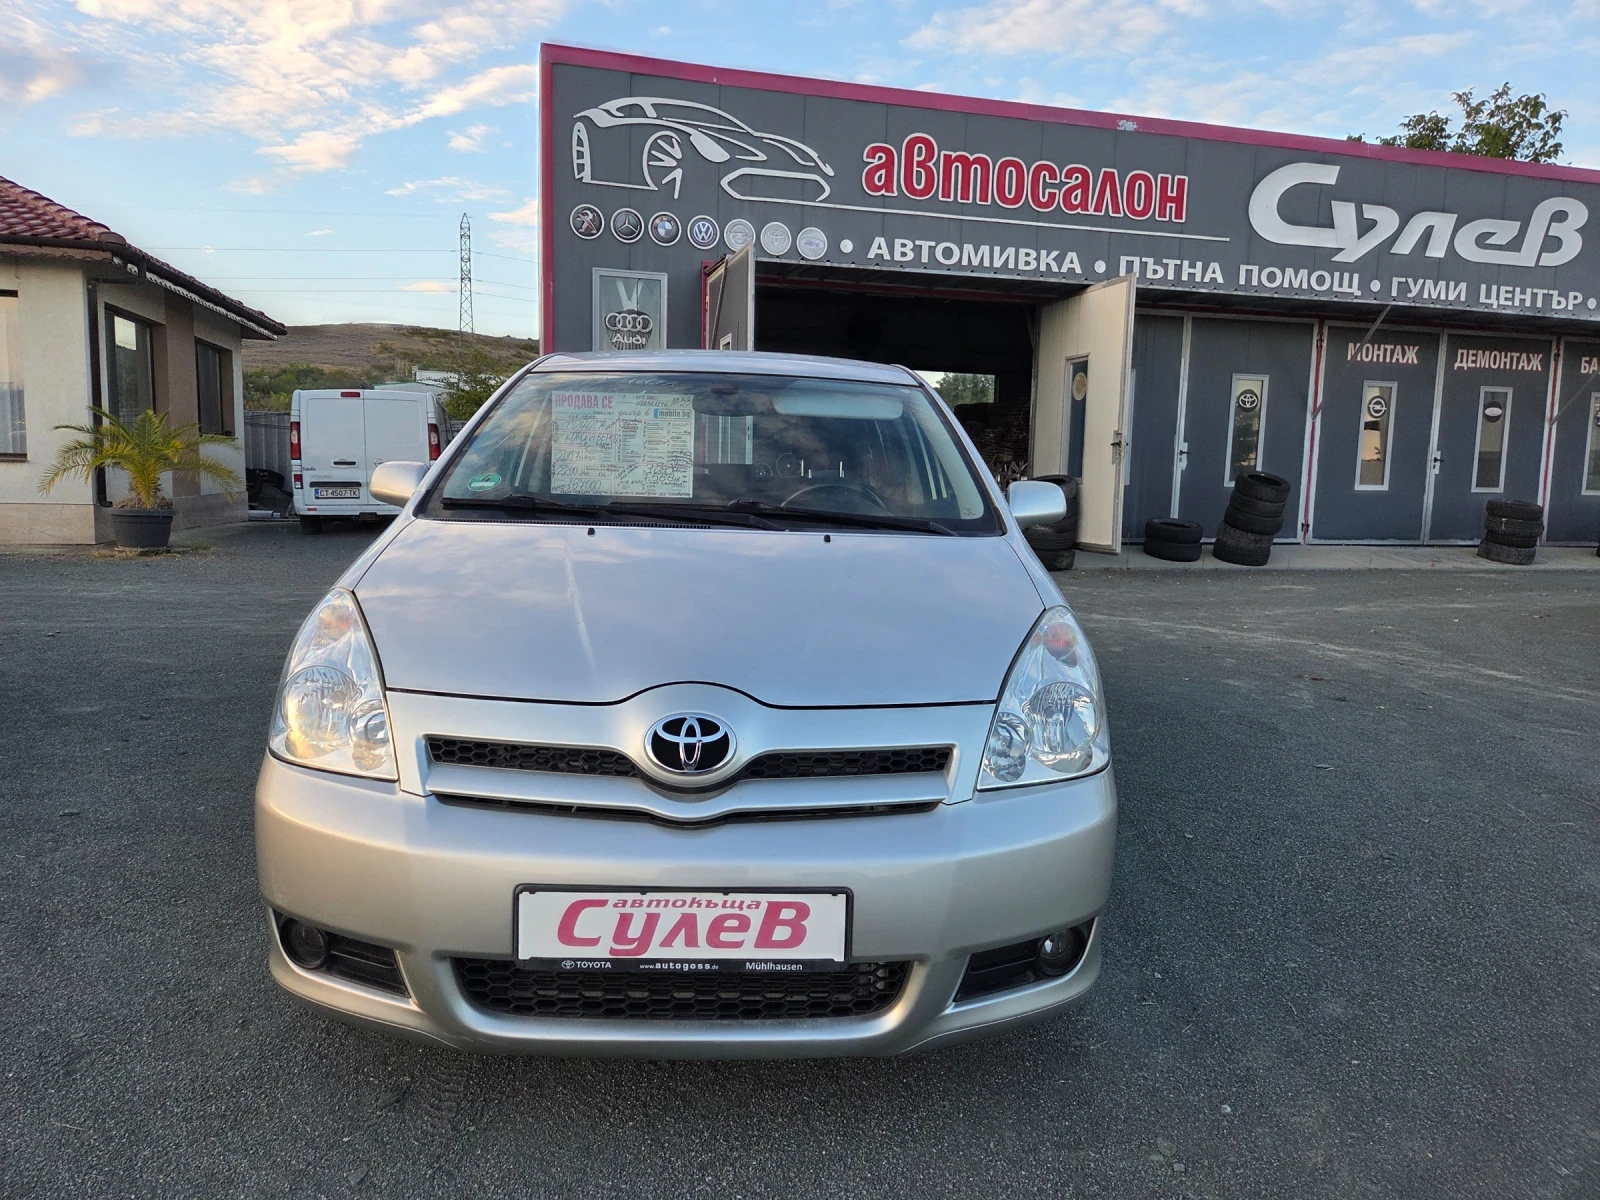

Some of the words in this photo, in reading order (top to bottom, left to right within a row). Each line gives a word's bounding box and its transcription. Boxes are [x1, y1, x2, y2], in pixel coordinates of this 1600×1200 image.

[862, 132, 1188, 223] автосалон
[866, 236, 1083, 274] АВТОМИВКА
[1119, 255, 1224, 284] ПЪТНА
[1238, 264, 1362, 296] ПОМОЩ
[1391, 276, 1467, 302] ГУМИ
[1479, 283, 1583, 311] ЦЕНТЪР
[611, 333, 646, 345] Audi
[1347, 342, 1419, 365] МОНТАЖ
[1453, 349, 1543, 371] ДЕМОНТАЖ
[1580, 356, 1600, 375] БА
[555, 393, 599, 410] ПРОДАВА
[601, 395, 614, 409] СЕ
[658, 409, 691, 419] mobile.bg
[320, 489, 329, 497] CT
[330, 489, 347, 497] 4507
[349, 489, 358, 497] TK
[612, 897, 762, 911] автокъща
[576, 961, 612, 969] TOYOTA
[639, 961, 719, 971] www.autogoss.de
[745, 961, 803, 971] Mühlhausen
